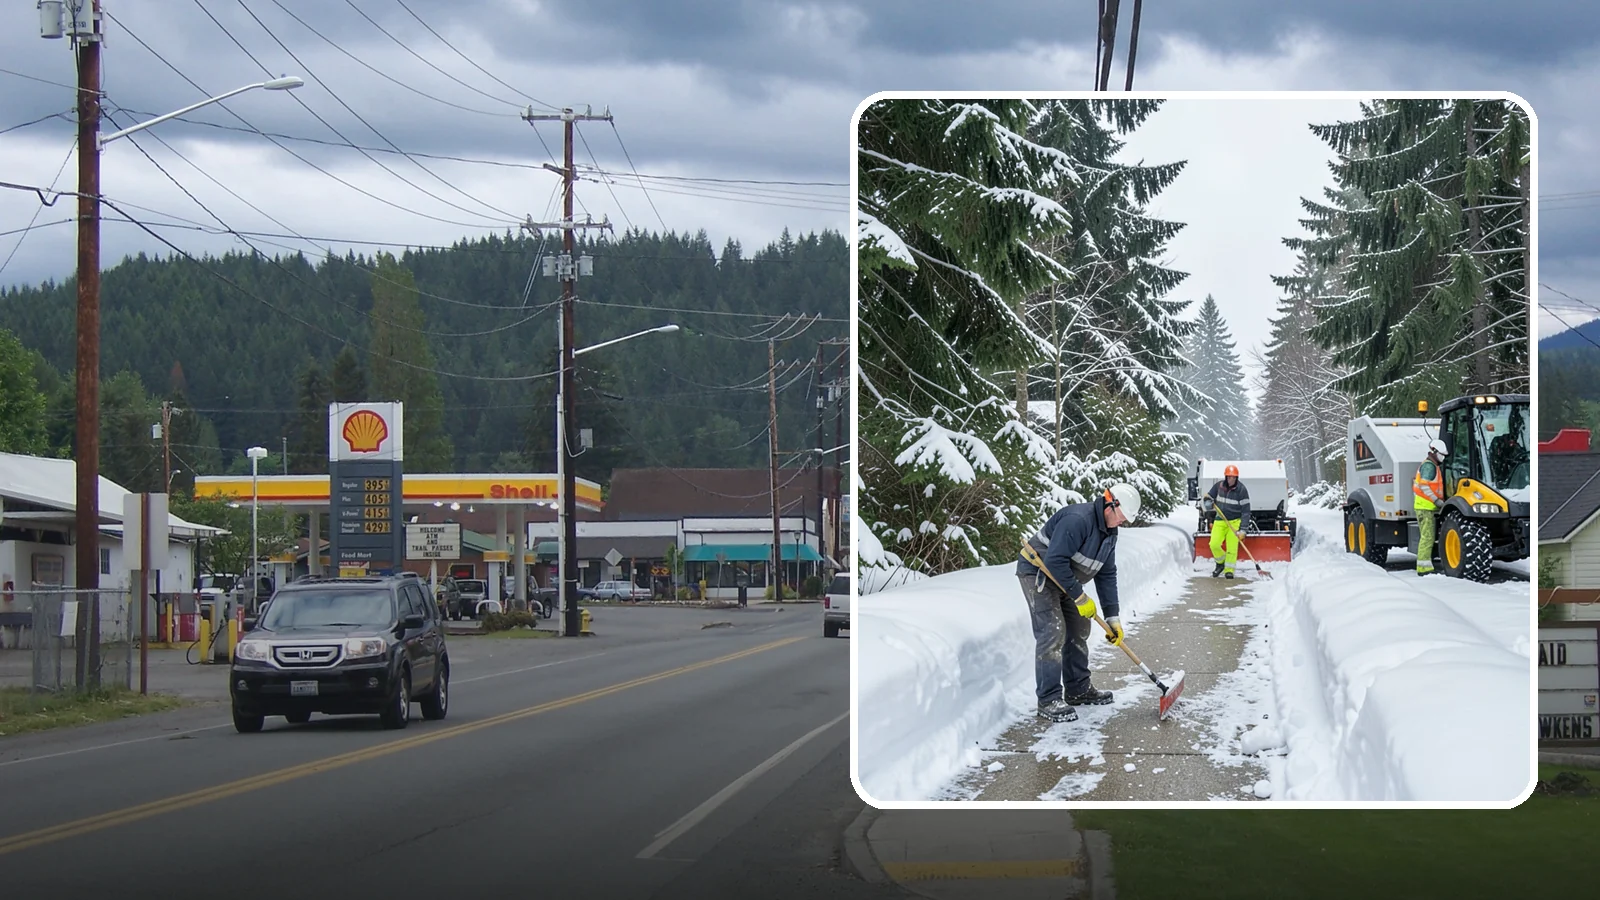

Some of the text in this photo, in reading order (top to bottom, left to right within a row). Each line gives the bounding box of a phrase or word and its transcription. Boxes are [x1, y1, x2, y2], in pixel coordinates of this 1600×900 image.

[365, 480, 383, 490] 395
[490, 484, 547, 499] Shell
[365, 494, 383, 504] 405
[365, 508, 383, 518] 415
[365, 523, 383, 532] 429
